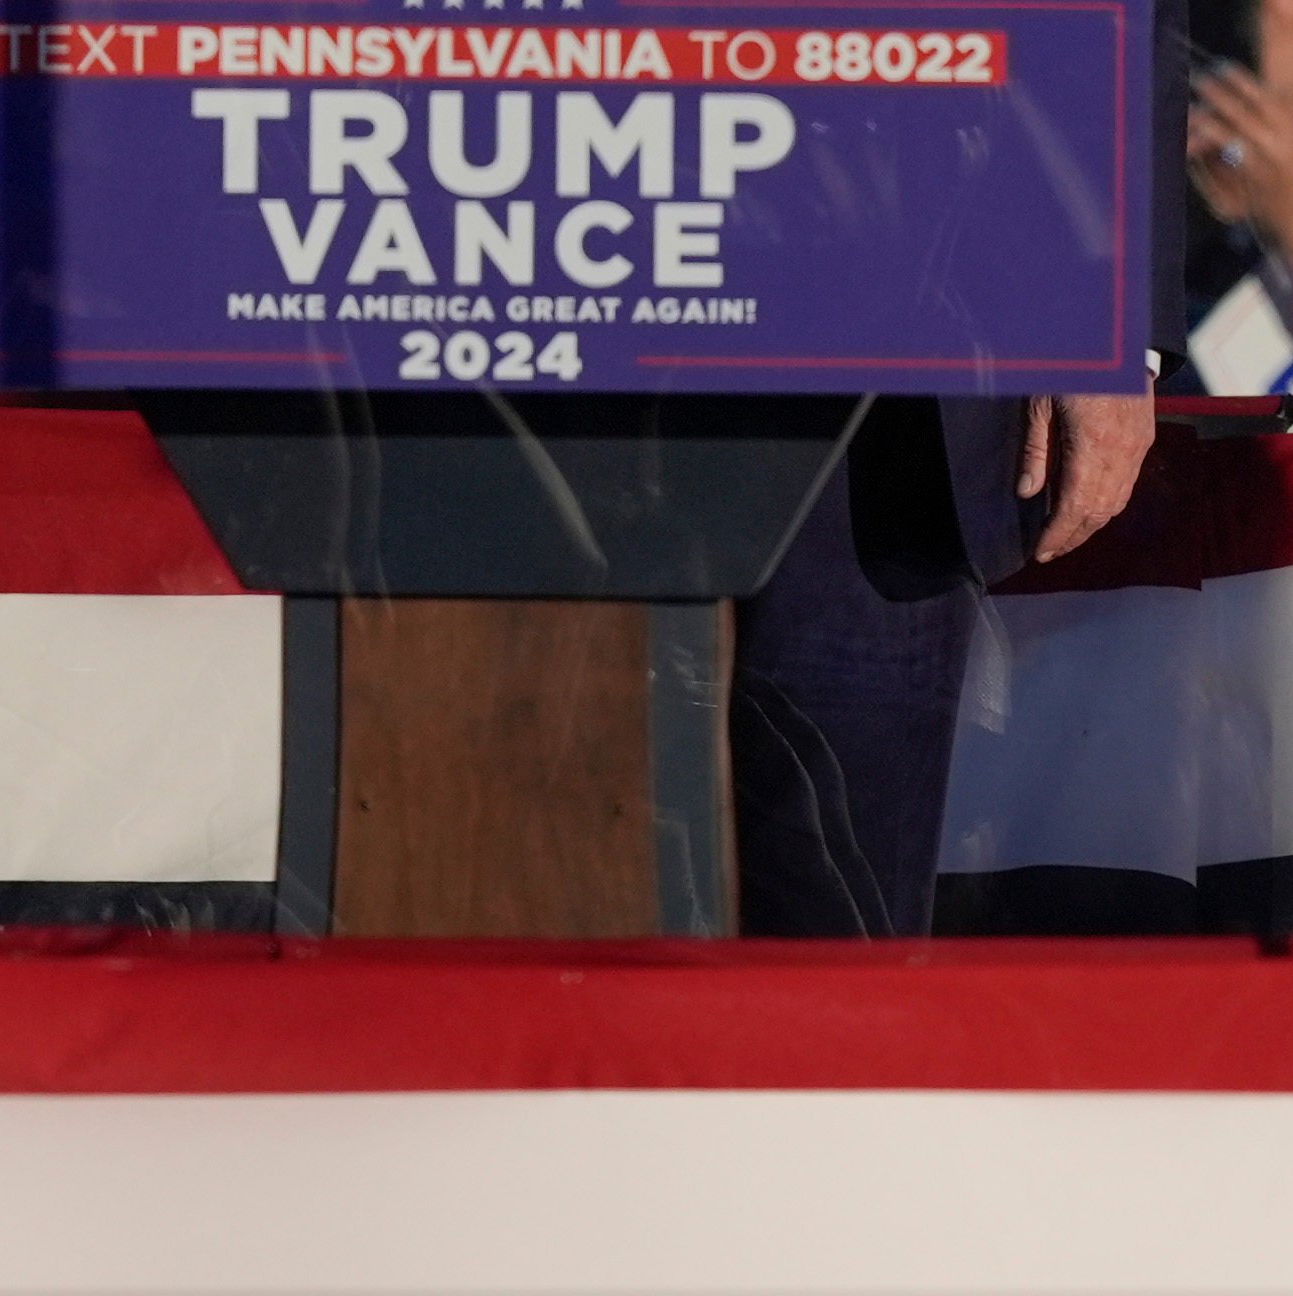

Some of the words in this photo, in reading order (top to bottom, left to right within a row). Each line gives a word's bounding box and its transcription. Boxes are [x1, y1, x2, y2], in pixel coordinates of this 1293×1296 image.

[178, 25, 673, 81] PENNSYLVANIA
[688, 31, 777, 82] TO
[793, 31, 993, 84] 88022
[191, 89, 797, 198] TRUMP
[259, 198, 724, 289] VANCE
[227, 294, 326, 322] MAKE
[337, 295, 495, 323] AMERICA
[507, 296, 622, 324] GREAT
[632, 298, 758, 325] AGAIN!
[399, 331, 585, 382] 2024
